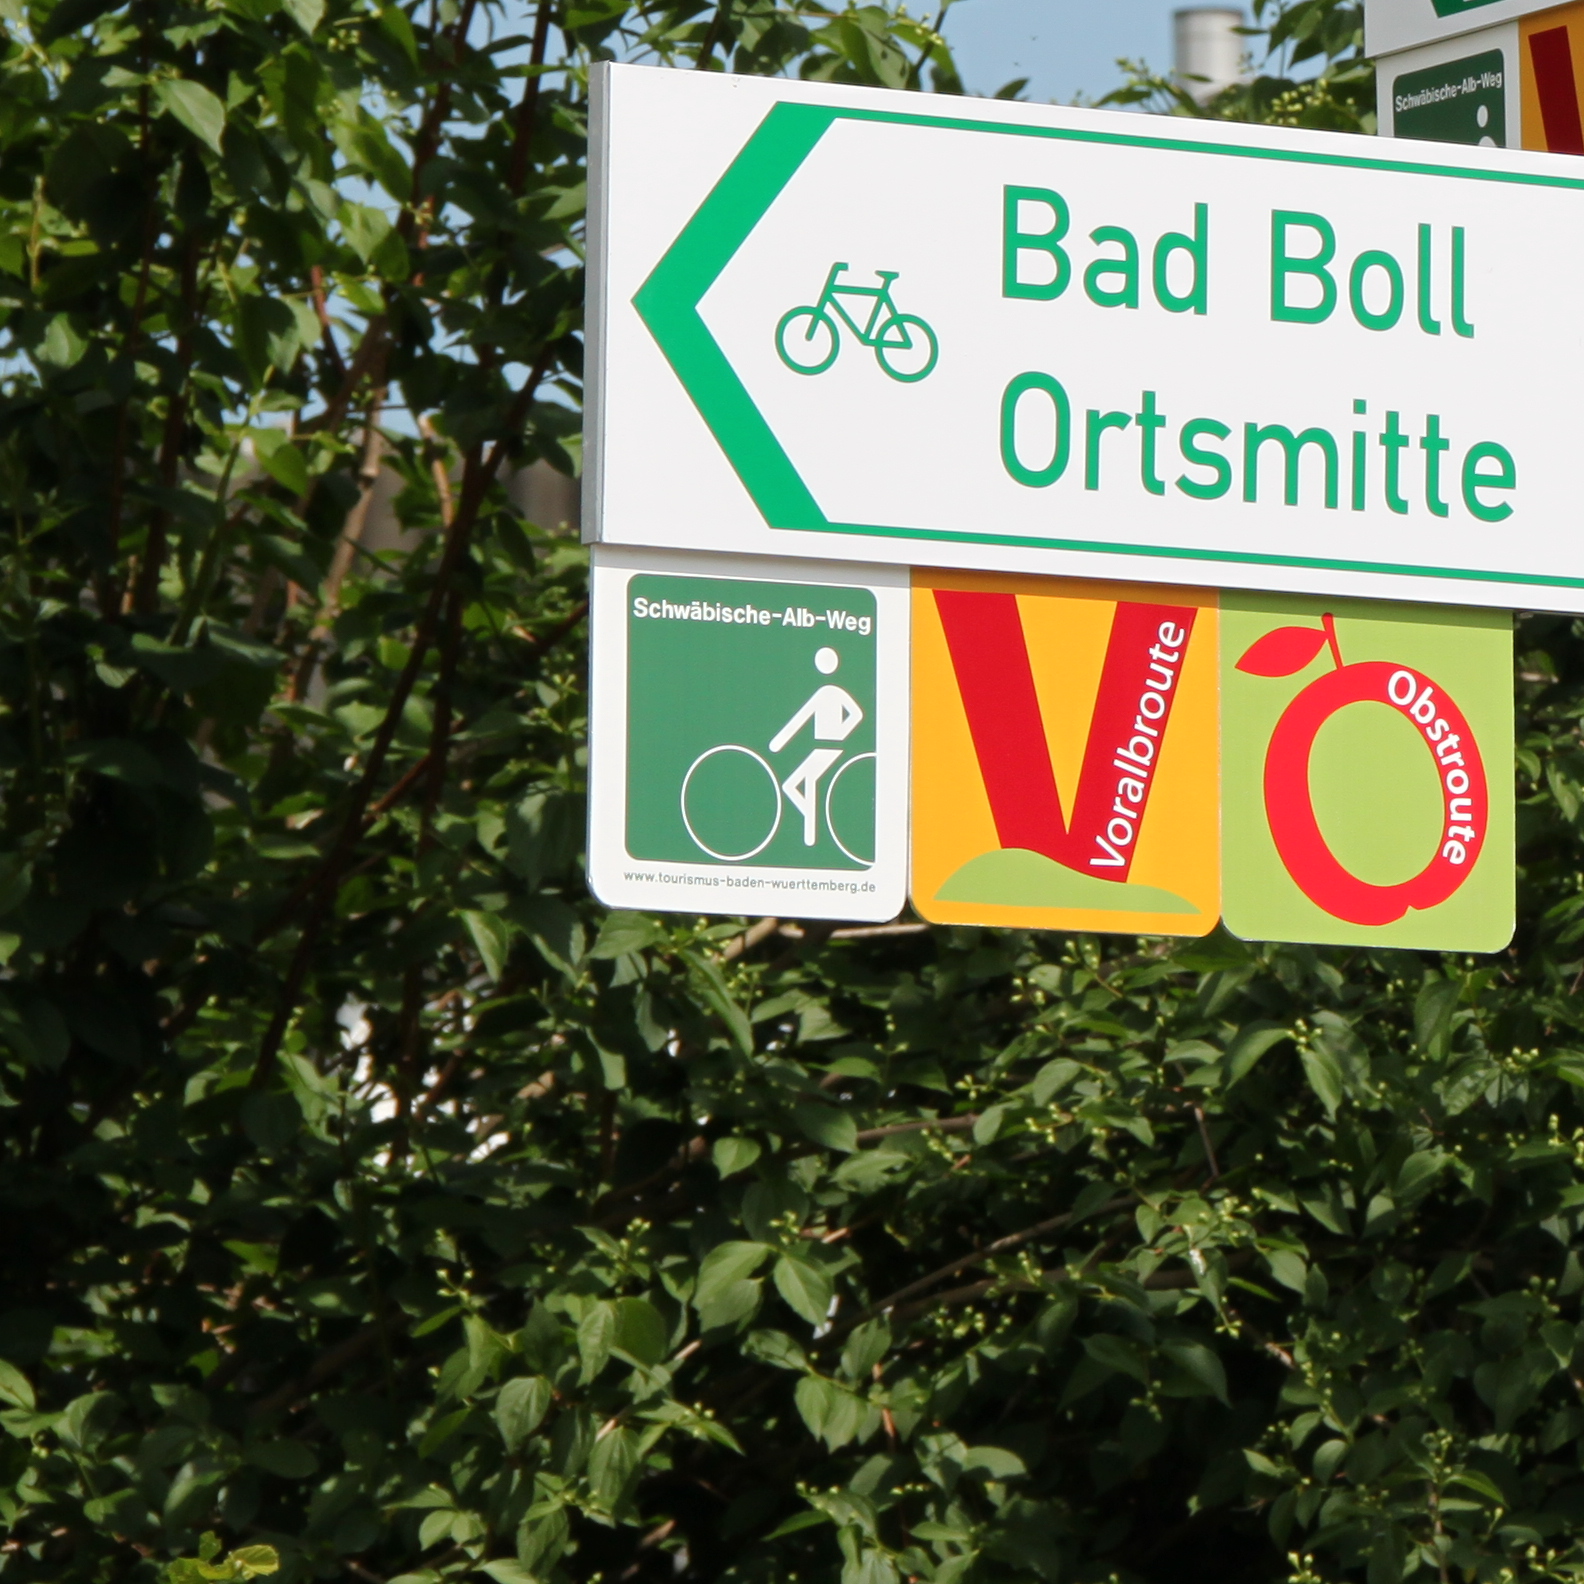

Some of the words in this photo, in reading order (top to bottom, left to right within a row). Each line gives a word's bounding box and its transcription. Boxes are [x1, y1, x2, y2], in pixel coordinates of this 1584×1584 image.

[1395, 70, 1503, 112] Schwäbische-Alb-Weg
[1001, 184, 1210, 316] Bad
[1270, 208, 1476, 339] Boll
[1000, 370, 1518, 523] Ortsmitte
[632, 596, 873, 637] Schwäbische-Alb-Weg
[1089, 619, 1186, 872] Voralbroute
[1385, 669, 1474, 867] Obstroute
[622, 869, 877, 896] www.tourismus-baden-wuerttemberg.de
